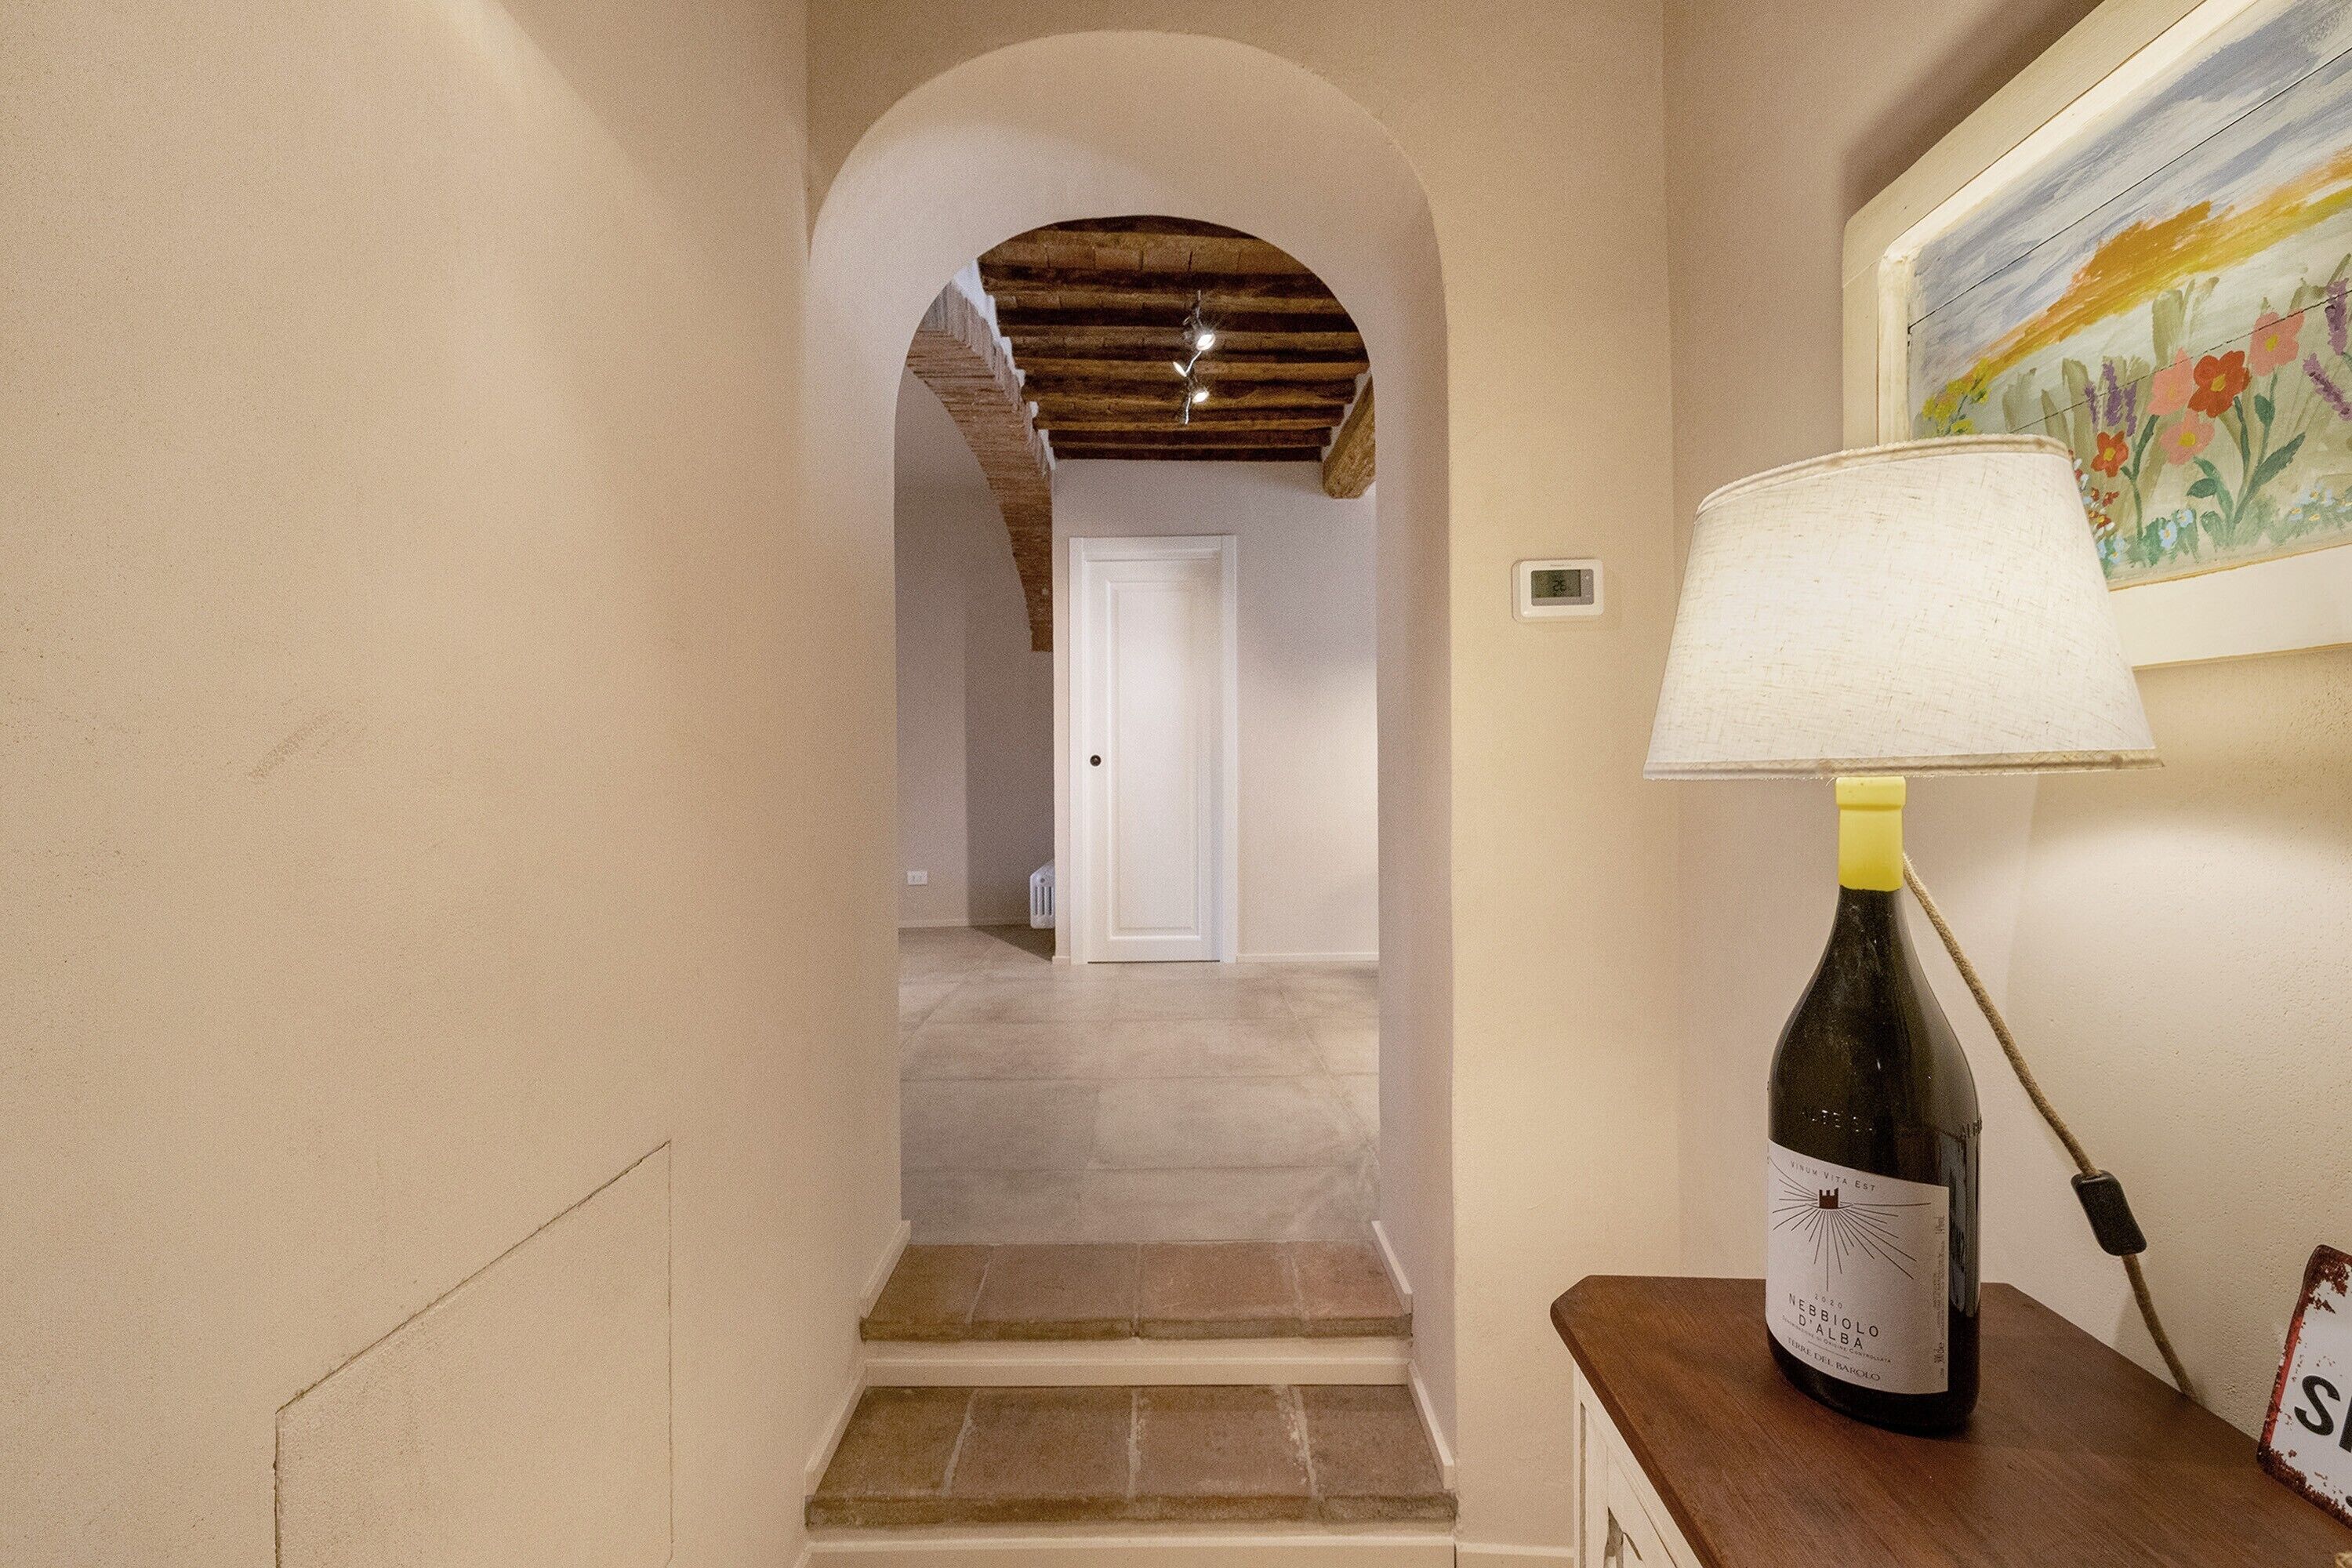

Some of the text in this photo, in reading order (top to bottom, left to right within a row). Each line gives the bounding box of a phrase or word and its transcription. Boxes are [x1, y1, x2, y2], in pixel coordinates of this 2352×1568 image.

[1791, 1160, 1876, 1192] VINUM VITA EST
[1788, 1293, 1879, 1338] NEBBIOLO
[1814, 1293, 1843, 1309] 2020
[1788, 1336, 1881, 1381] TERRE DEL BAROLO
